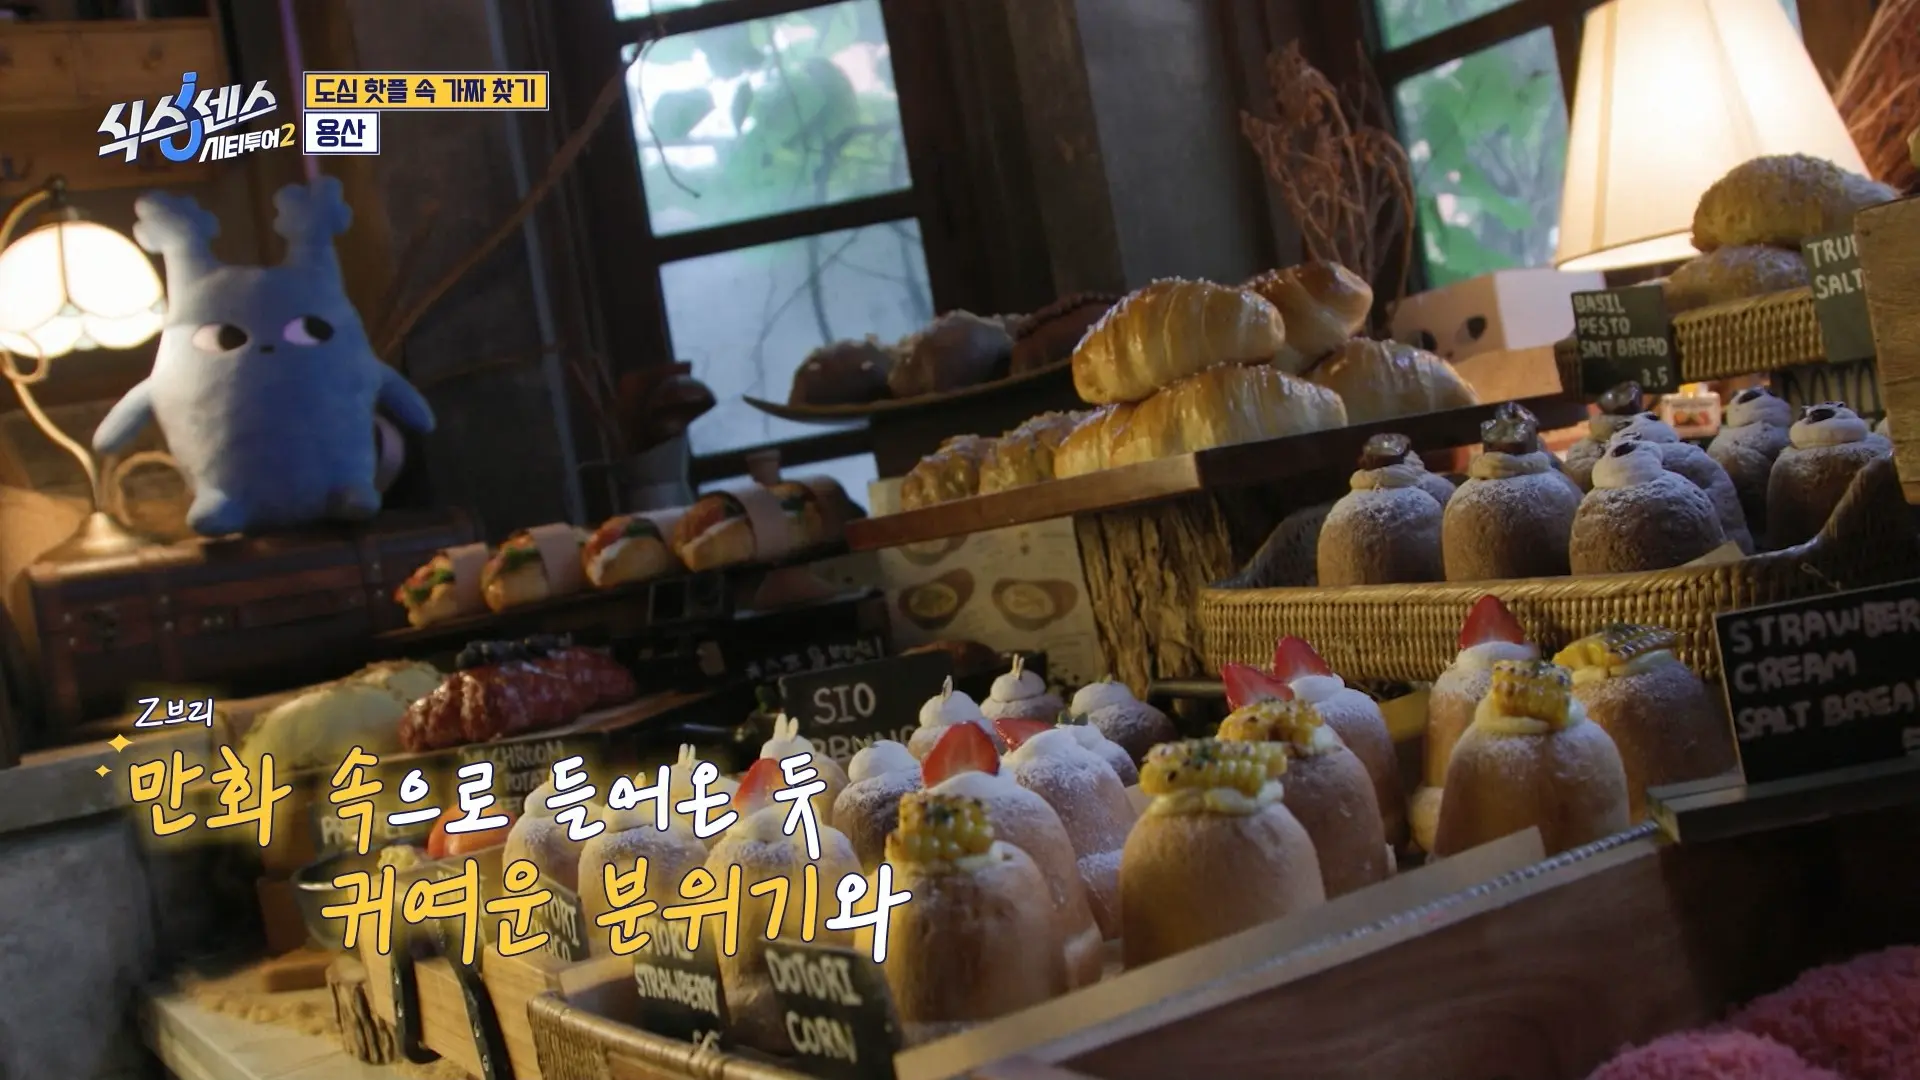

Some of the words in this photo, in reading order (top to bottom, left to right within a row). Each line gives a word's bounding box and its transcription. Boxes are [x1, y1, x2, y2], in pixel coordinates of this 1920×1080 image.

[1805, 233, 1858, 269] TRU
[1814, 267, 1865, 300] SALT
[1574, 293, 1626, 314] BASIL
[1578, 316, 1631, 337] PESTO
[1616, 336, 1669, 358] BREAD
[1733, 648, 1857, 693] CREAM
[813, 682, 876, 725] SIO
[1736, 700, 1812, 741] SALT
[1821, 680, 1920, 727] BREA
[764, 949, 863, 1006] DOTORI
[785, 1010, 858, 1064] CORN
